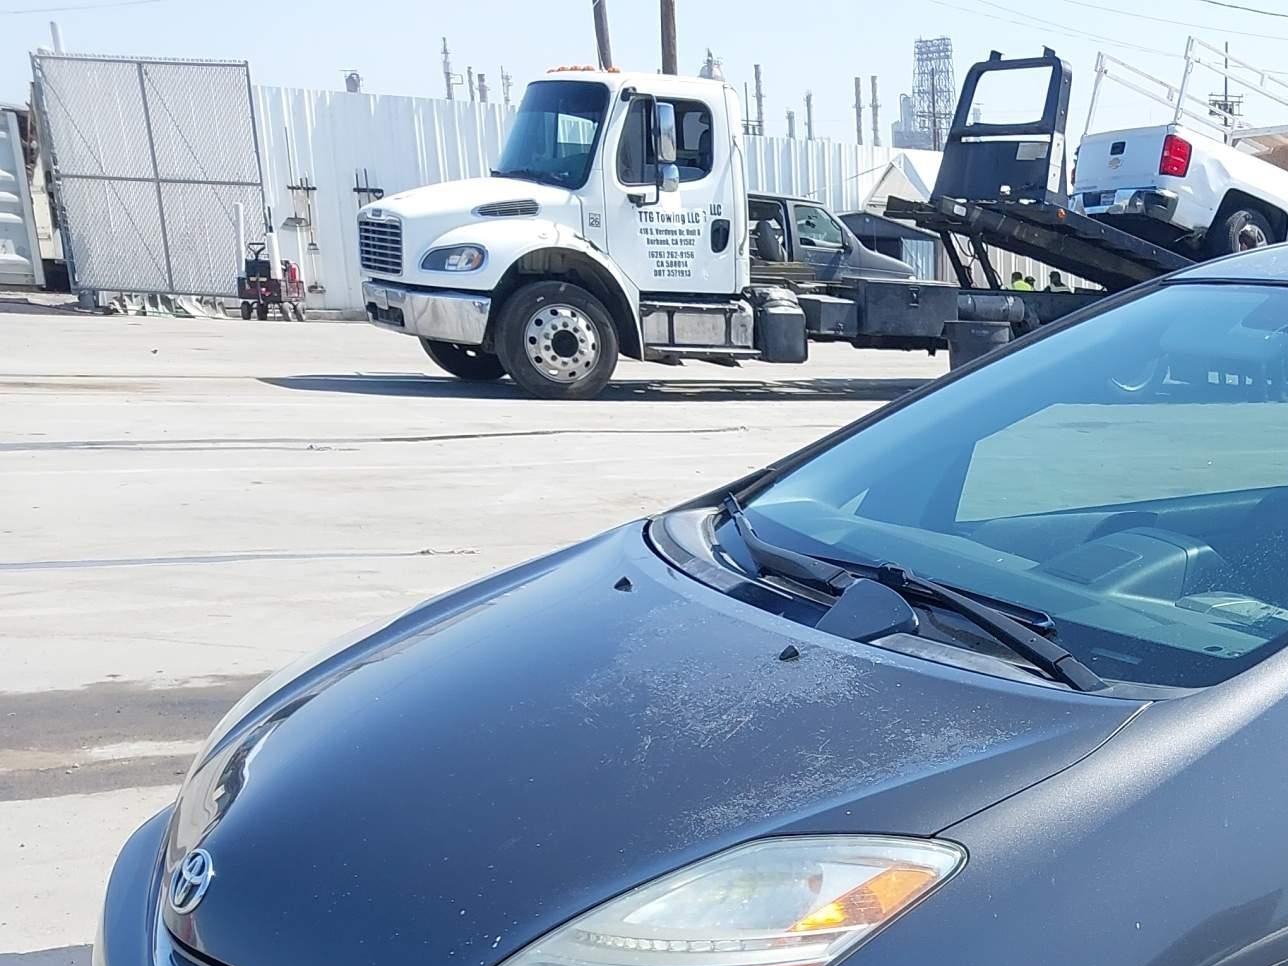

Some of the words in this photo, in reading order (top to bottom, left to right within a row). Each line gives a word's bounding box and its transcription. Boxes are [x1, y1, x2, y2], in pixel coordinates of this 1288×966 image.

[709, 204, 722, 216] LLC
[638, 211, 654, 223] TTG
[656, 211, 685, 225] Towing
[687, 212, 700, 224] LLC
